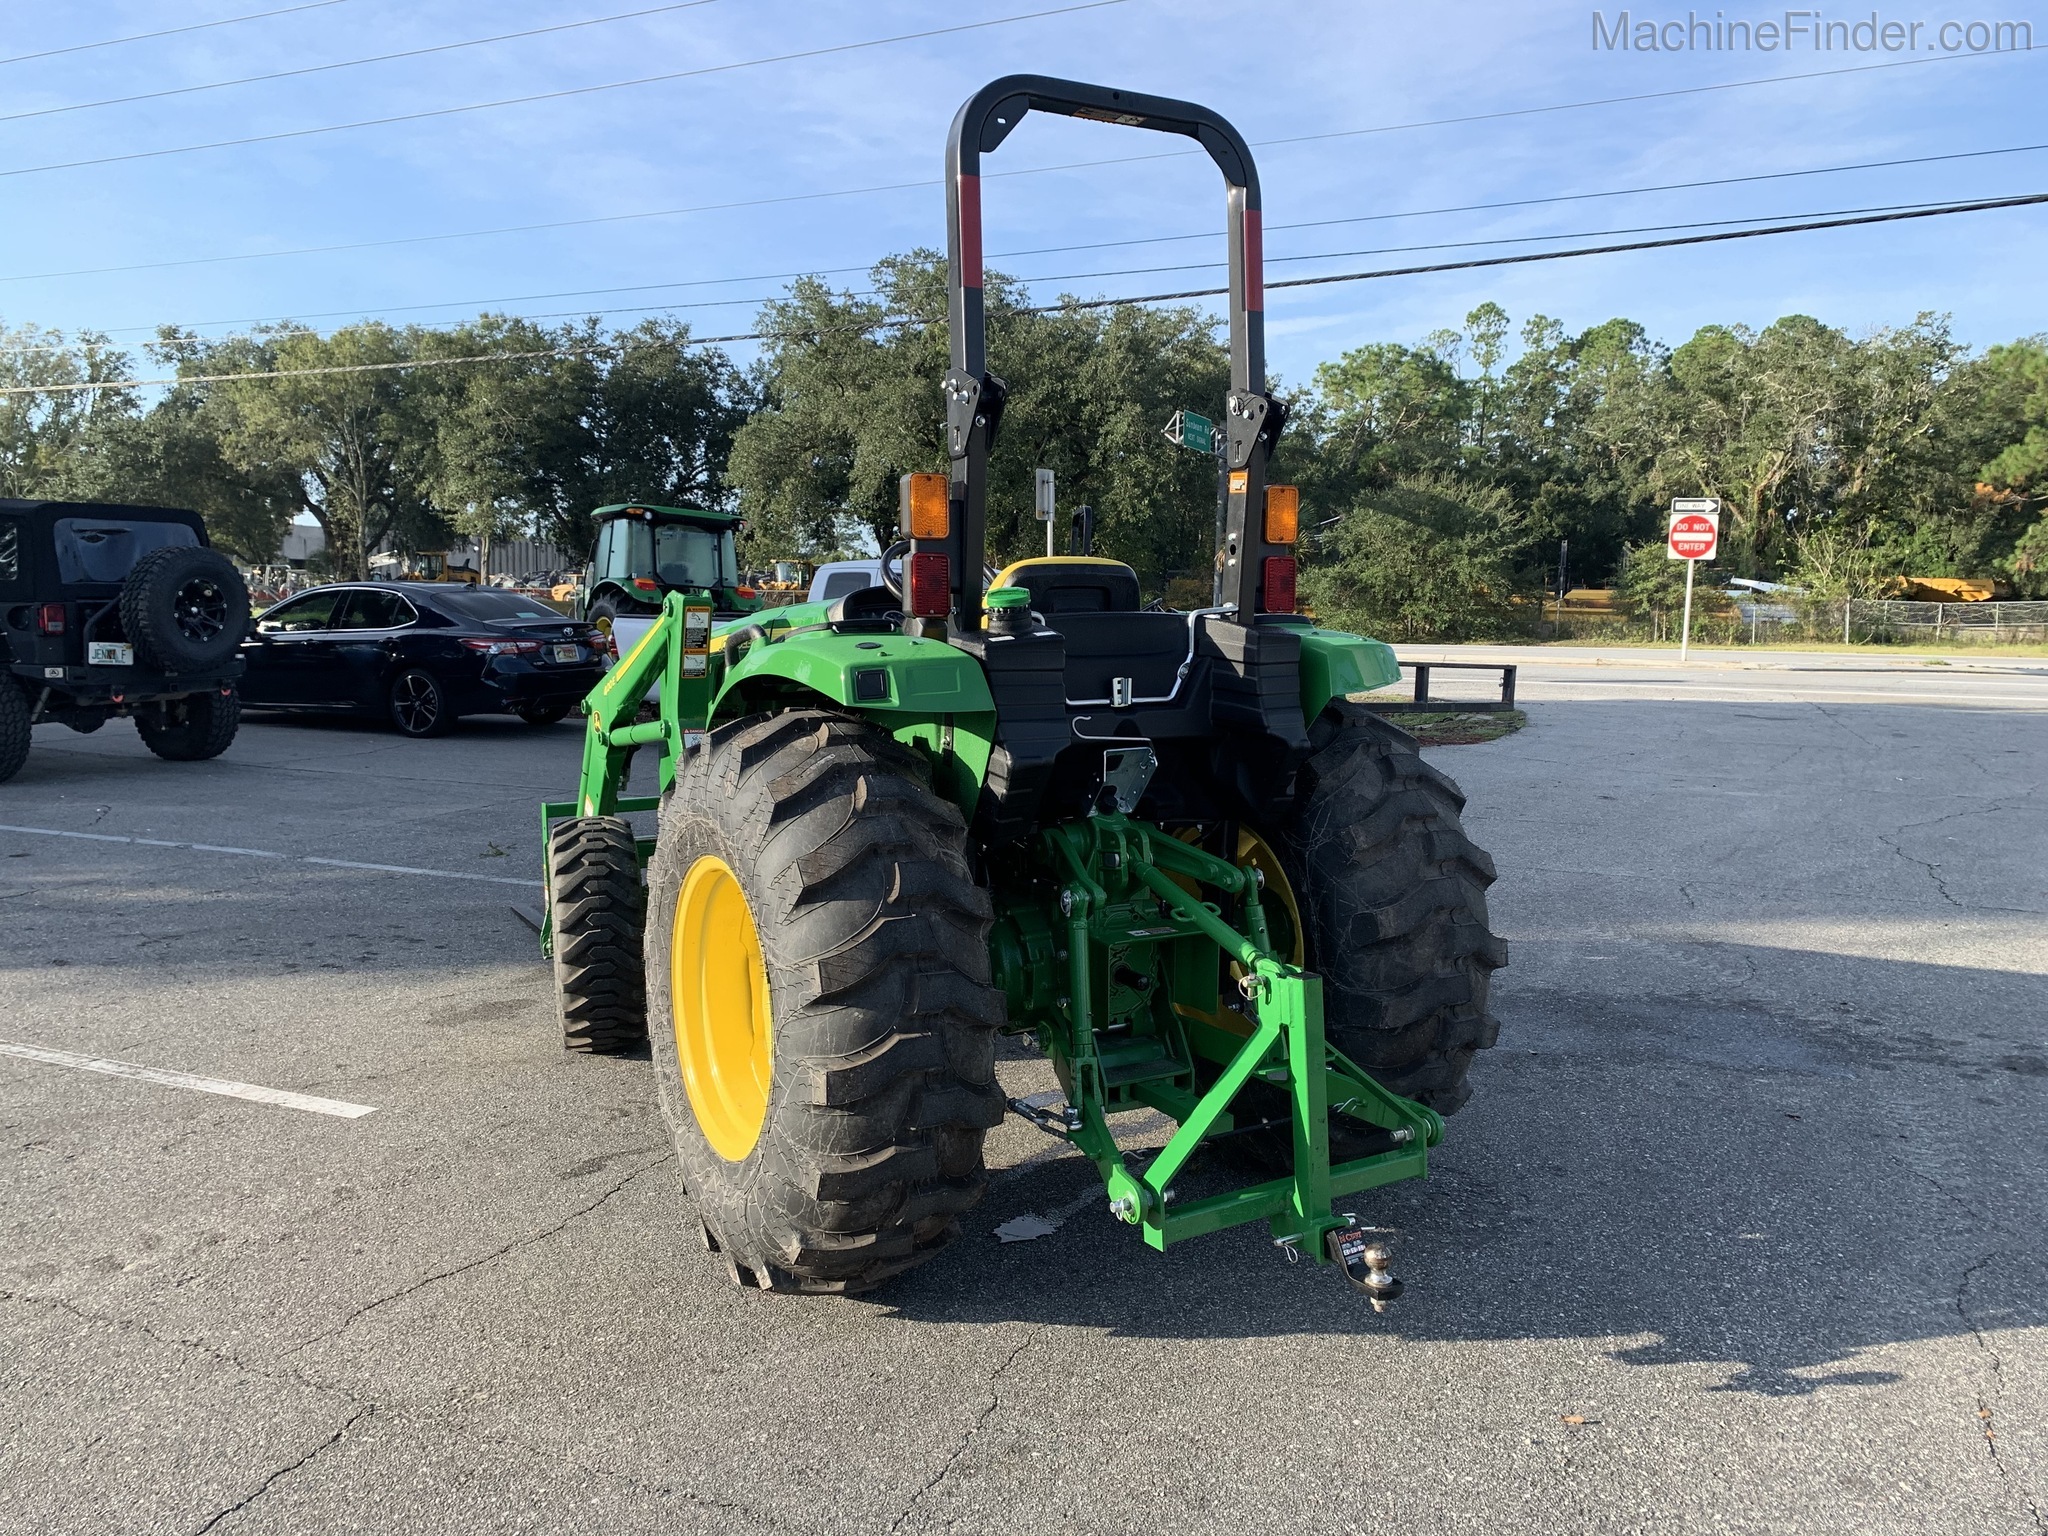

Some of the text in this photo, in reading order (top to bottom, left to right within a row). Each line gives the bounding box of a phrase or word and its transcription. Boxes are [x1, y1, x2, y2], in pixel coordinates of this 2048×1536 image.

[1676, 523, 1711, 531] DO NOT
[1677, 542, 1706, 551] ENTER
